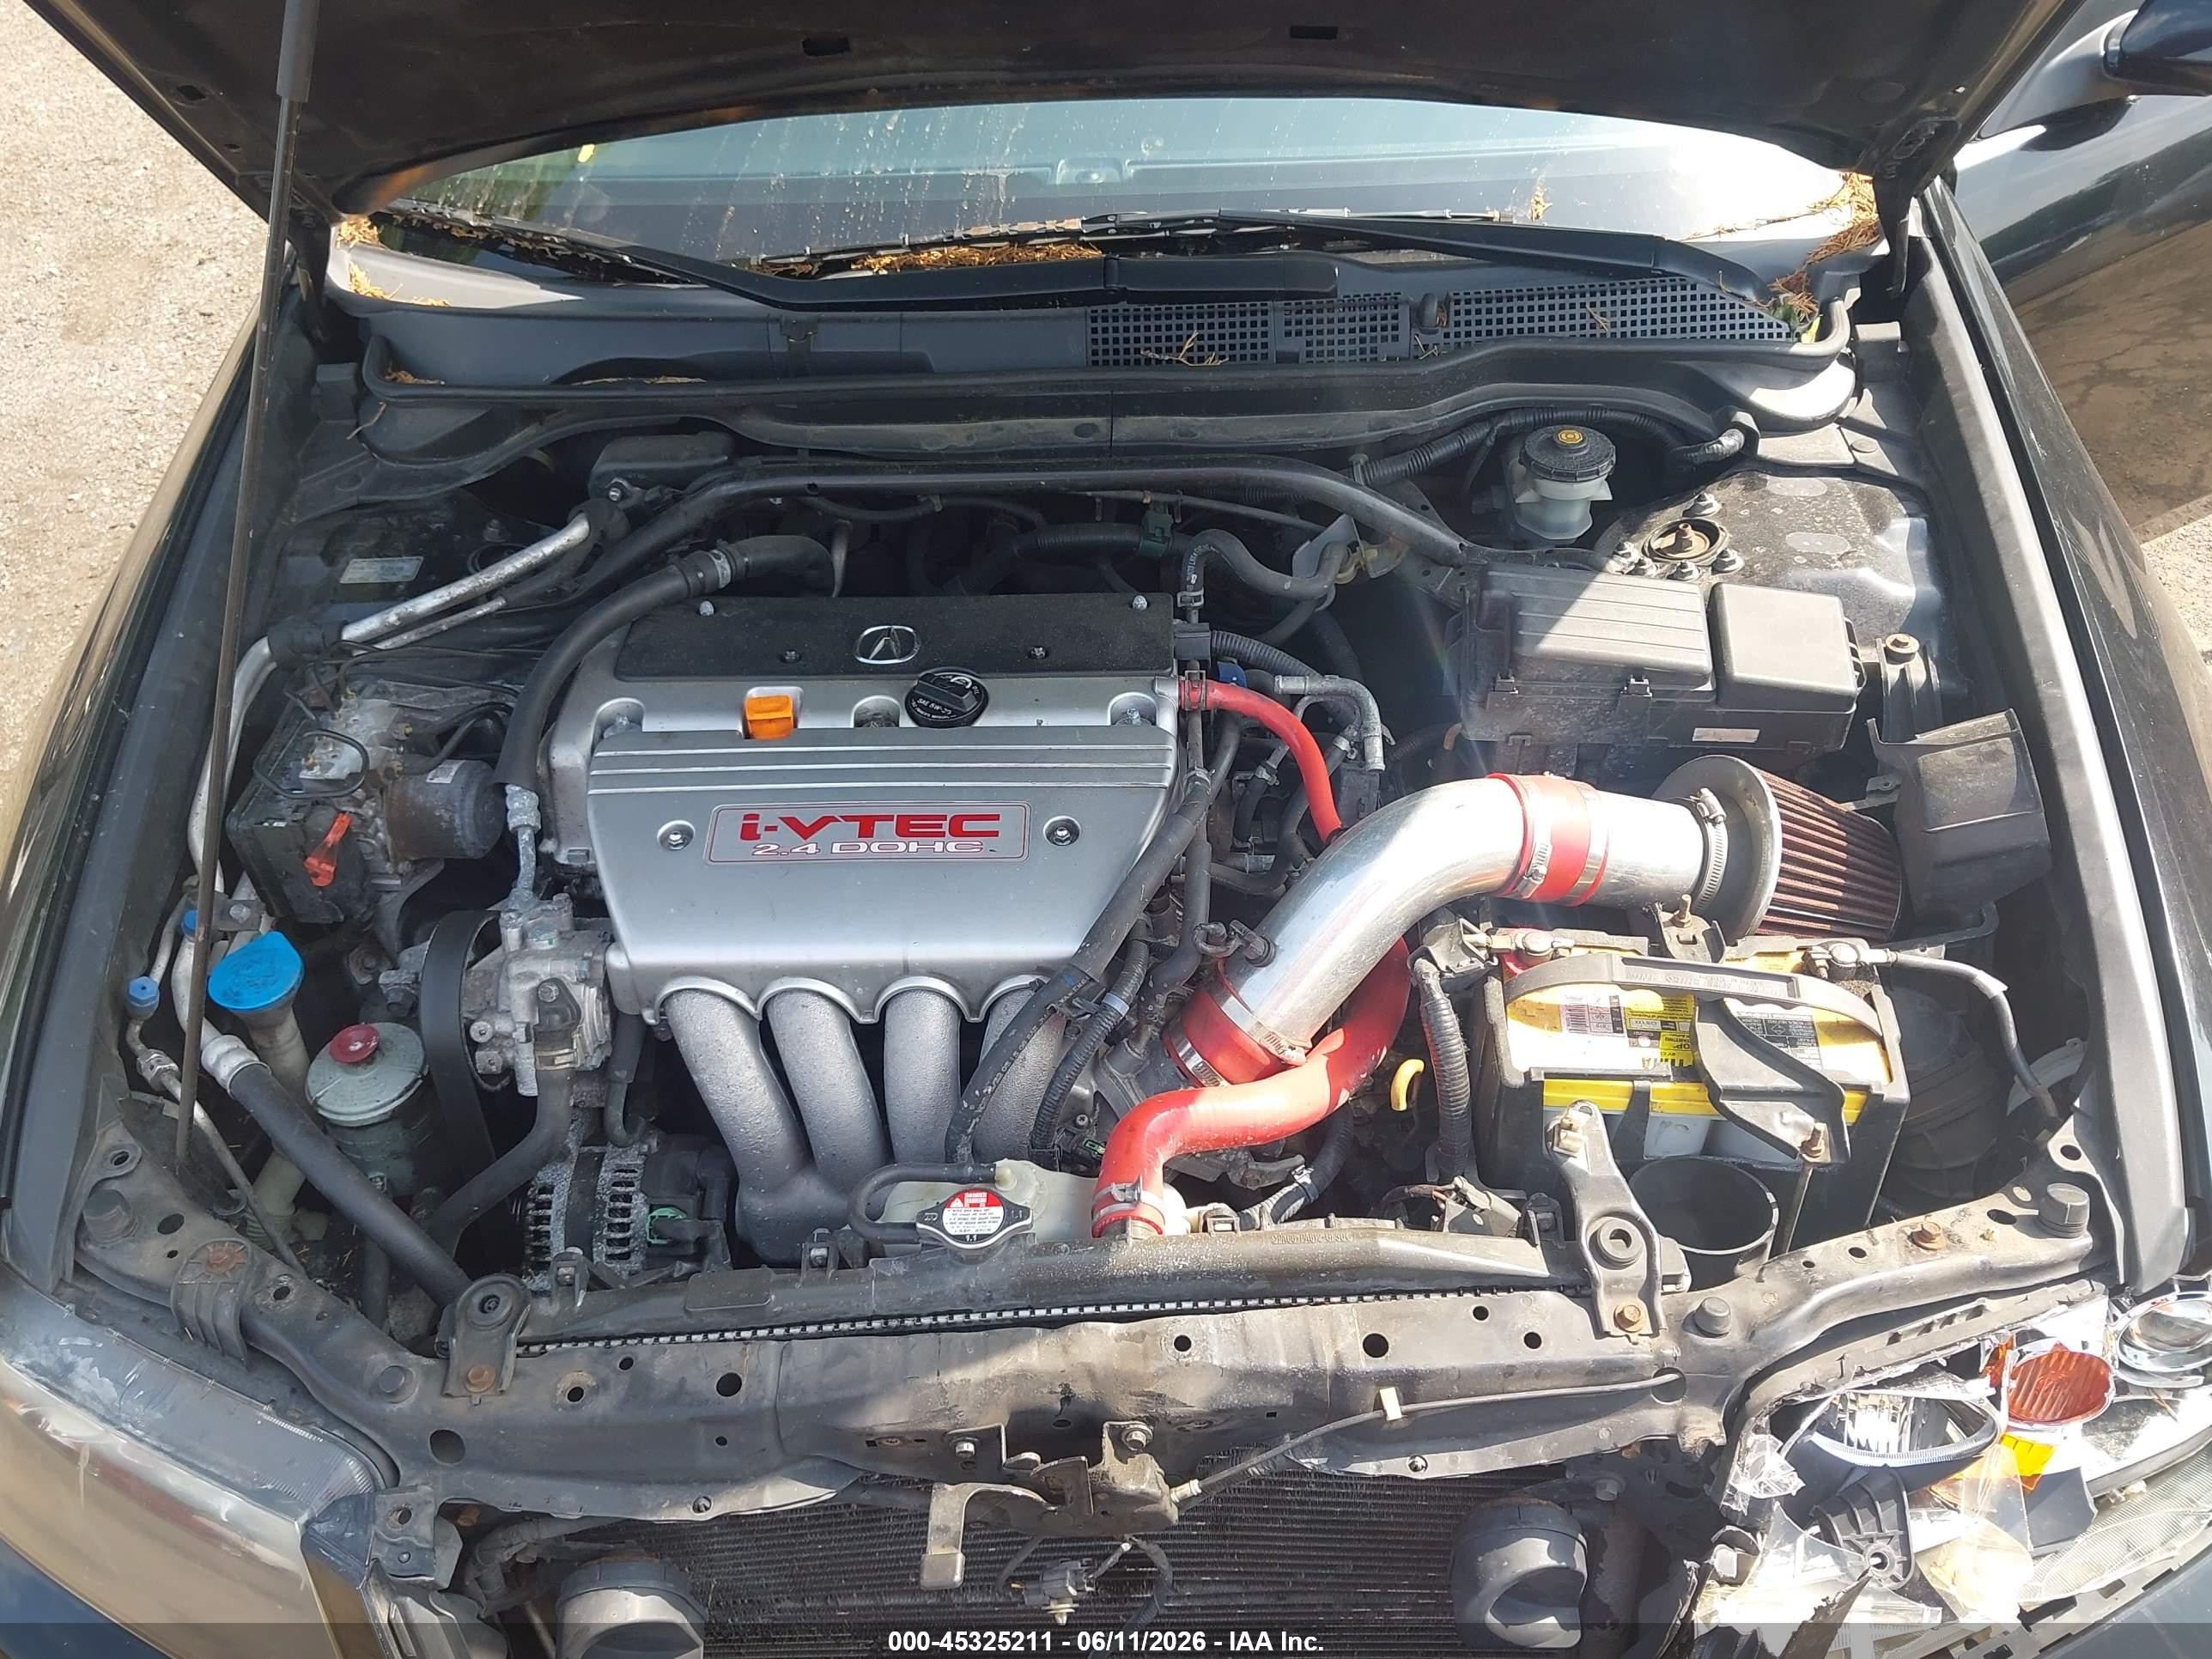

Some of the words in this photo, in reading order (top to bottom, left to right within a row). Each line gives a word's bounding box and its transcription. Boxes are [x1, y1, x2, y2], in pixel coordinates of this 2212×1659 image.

[916, 698, 929, 707] SAE
[739, 812, 1001, 842] i-VTEC
[751, 842, 821, 856] 2.4
[830, 840, 984, 855] DOHC
